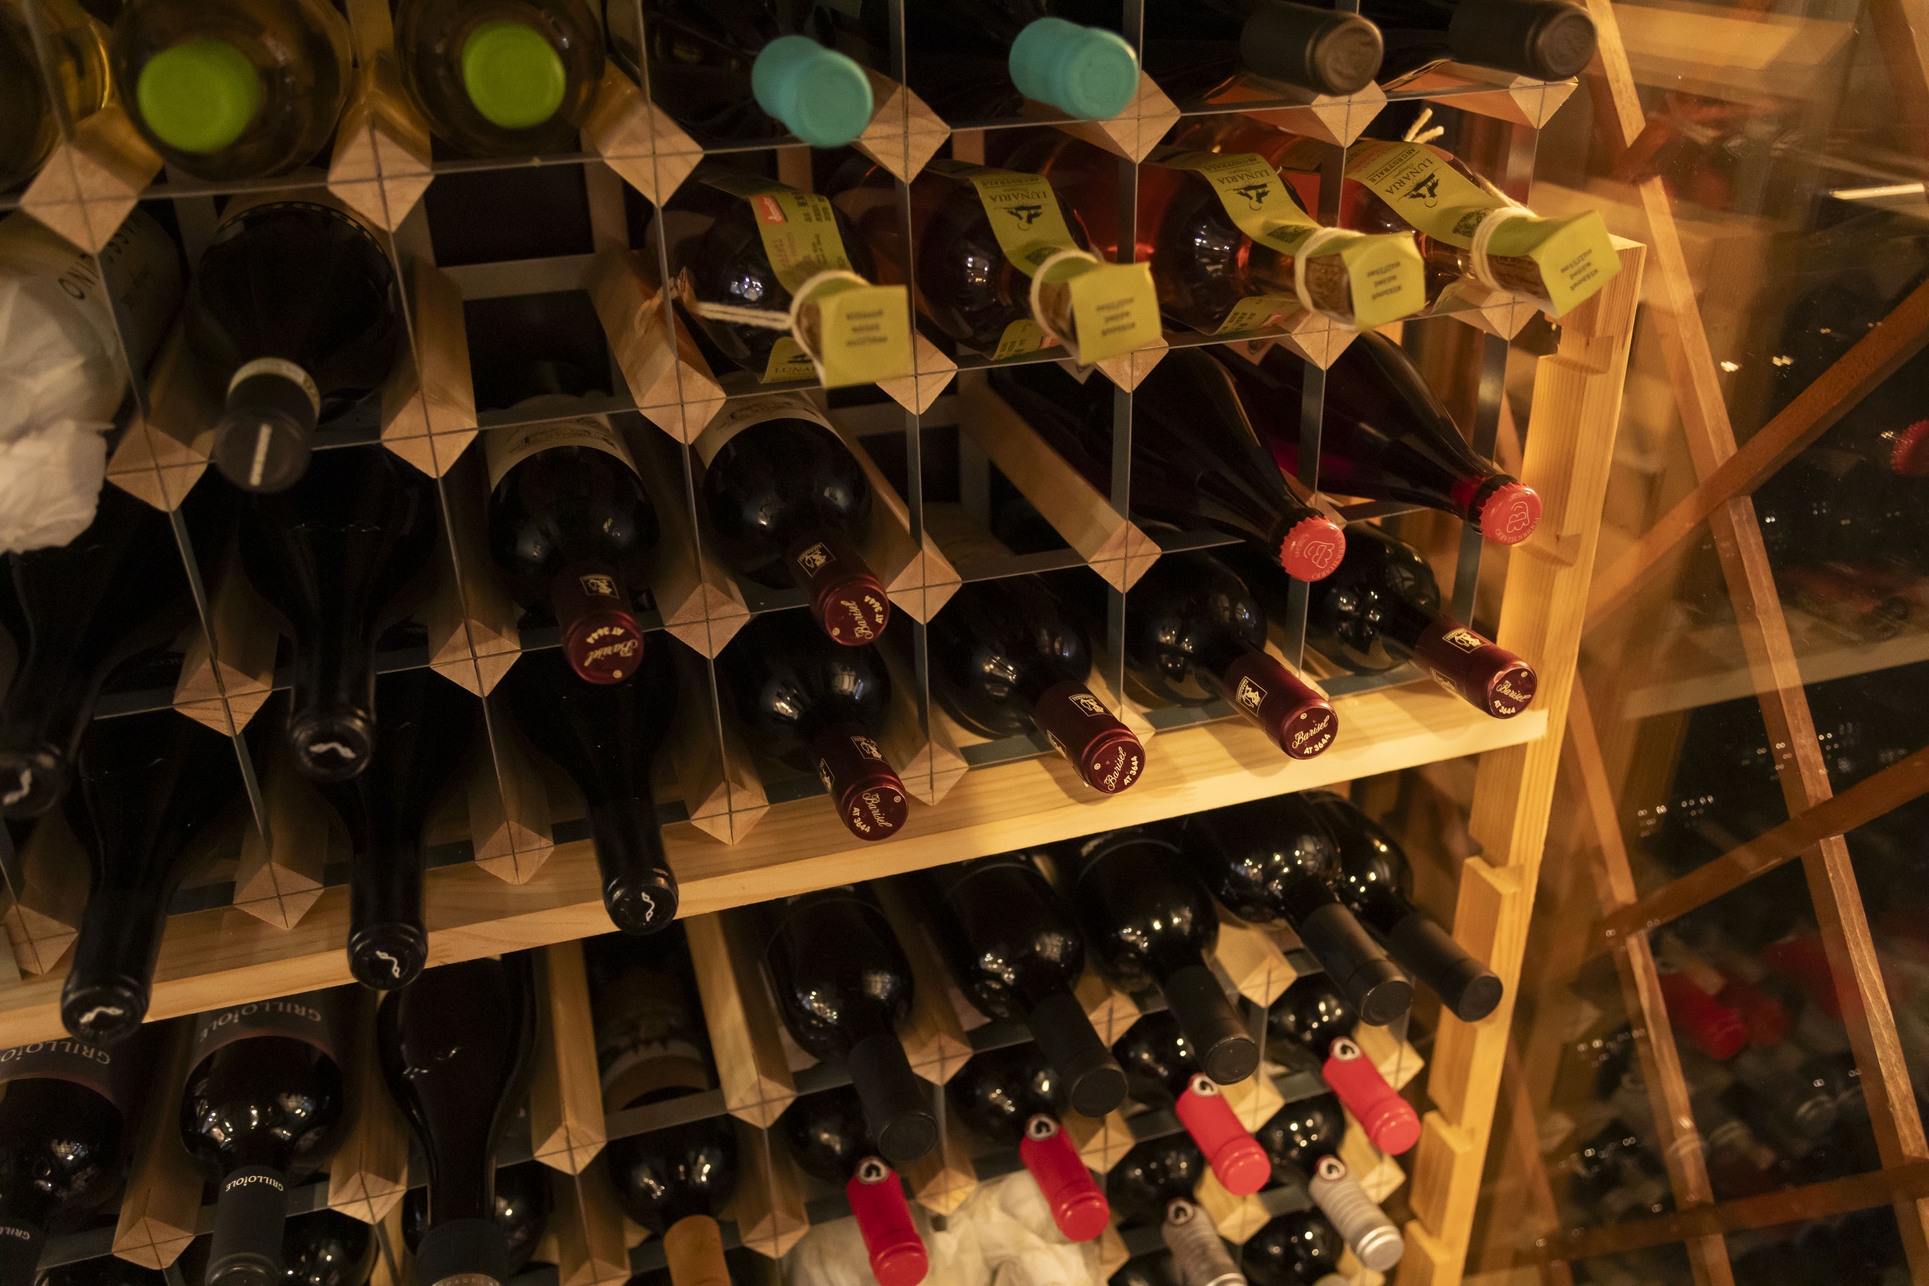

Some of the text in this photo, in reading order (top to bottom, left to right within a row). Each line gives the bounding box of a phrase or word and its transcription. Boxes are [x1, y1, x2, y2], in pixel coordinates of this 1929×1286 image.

[1216, 169, 1271, 185] LUNARIA
[1386, 157, 1434, 196] LUNARIA
[988, 191, 1048, 203] LUNARIA
[840, 600, 874, 640] Barisel
[1495, 680, 1532, 703] Barisel
[1291, 714, 1330, 750] Barisel
[1303, 746, 1313, 755] AT
[1103, 746, 1127, 791] Barisel
[1123, 775, 1133, 786] AT
[852, 806, 861, 817] AT
[861, 792, 893, 828] Barisel
